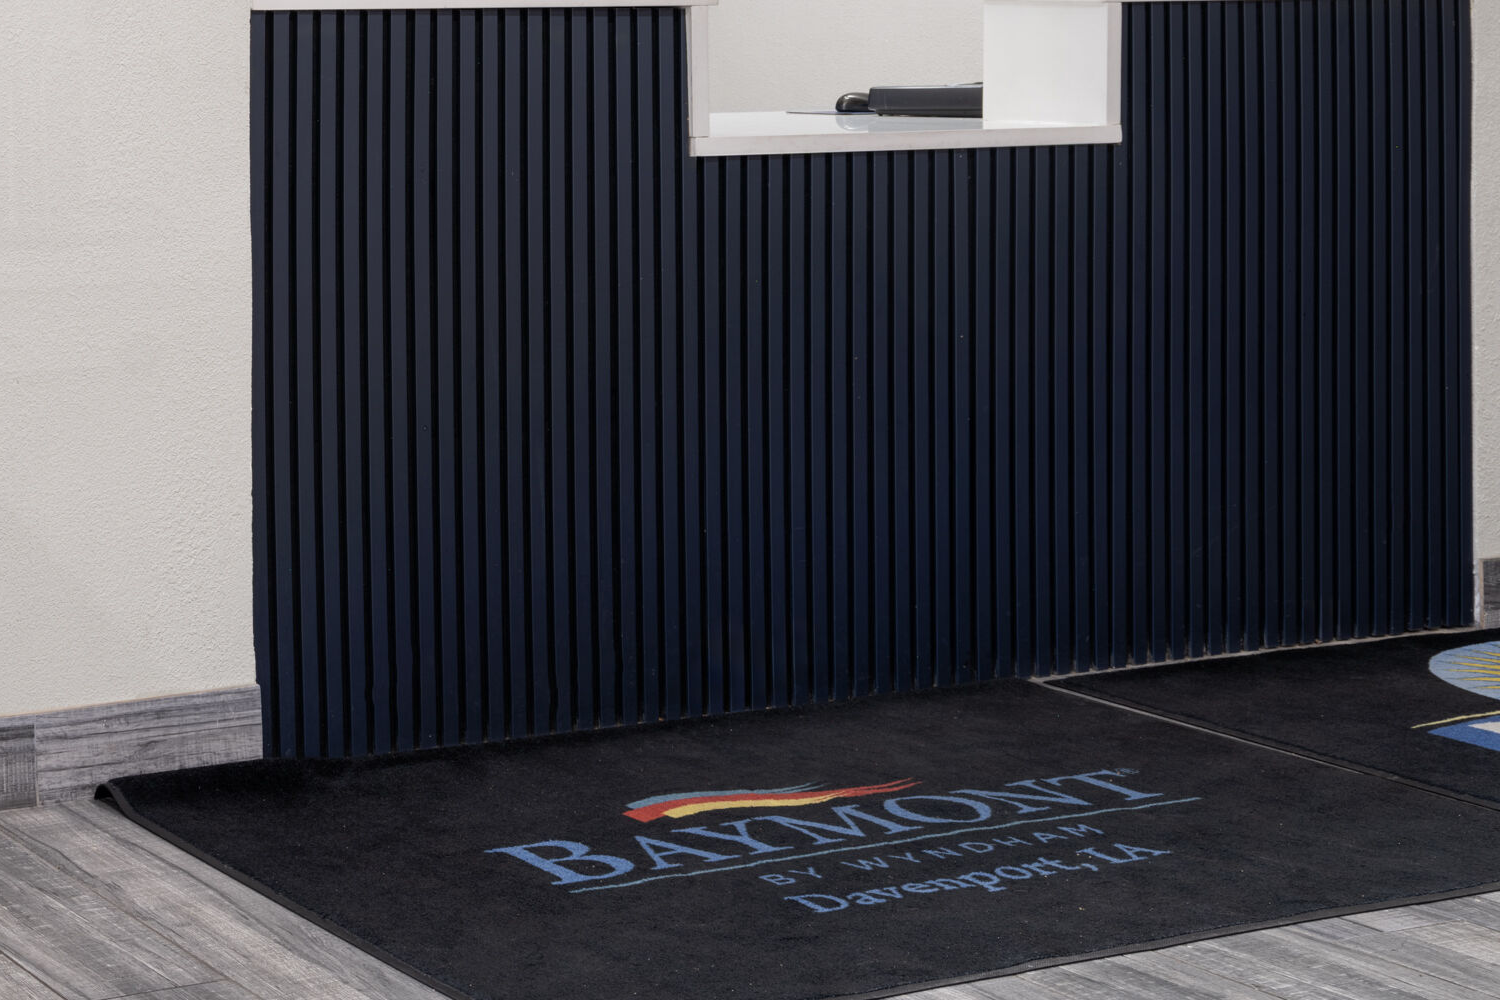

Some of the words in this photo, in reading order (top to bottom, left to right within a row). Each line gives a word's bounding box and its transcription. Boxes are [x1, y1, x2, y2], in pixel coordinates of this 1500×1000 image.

[484, 768, 1164, 885] BAYMONT
[759, 867, 822, 886] BY
[840, 824, 1104, 871] WYNDHAM
[784, 857, 1099, 913] Davenport,
[1076, 843, 1171, 864] IA
